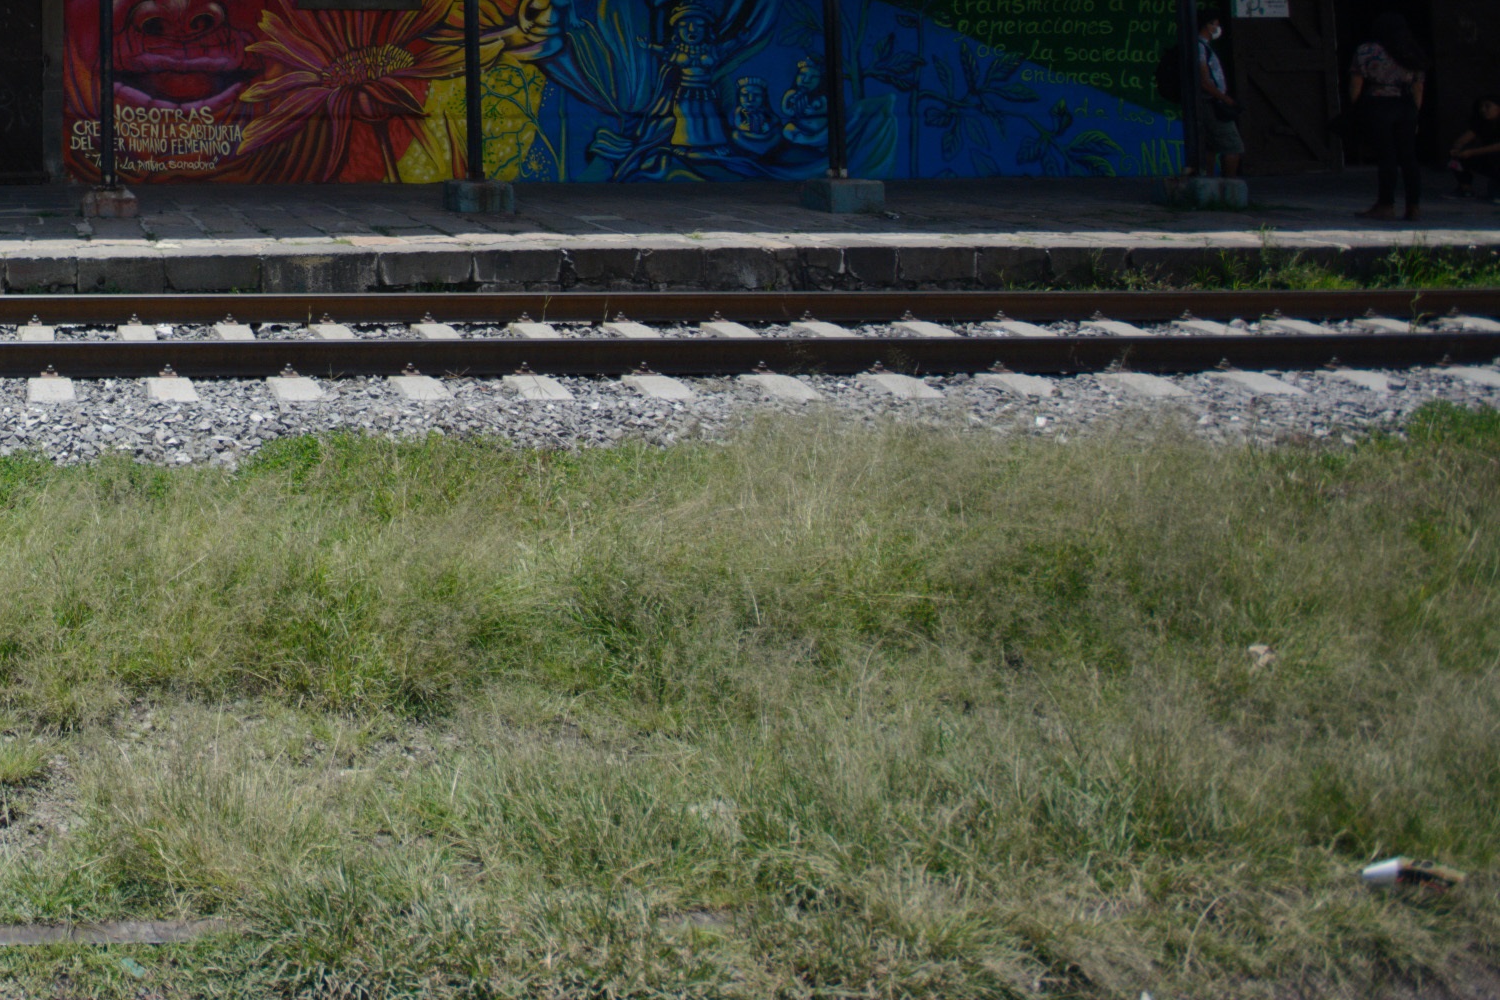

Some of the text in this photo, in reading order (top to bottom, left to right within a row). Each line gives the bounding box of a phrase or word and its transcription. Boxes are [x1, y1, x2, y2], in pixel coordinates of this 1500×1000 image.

[1108, 0, 1125, 12] a
[953, 17, 1113, 42] generaciones
[1129, 20, 1159, 47] por
[977, 35, 1006, 58] de
[1064, 38, 1161, 63] sociedad
[1021, 64, 1113, 88] entonces
[1120, 68, 1144, 89] la
[72, 120, 140, 138] CREMOS
[70, 135, 95, 151] DEL
[129, 138, 167, 154] HUMANO
[171, 139, 231, 156] FEMENINO
